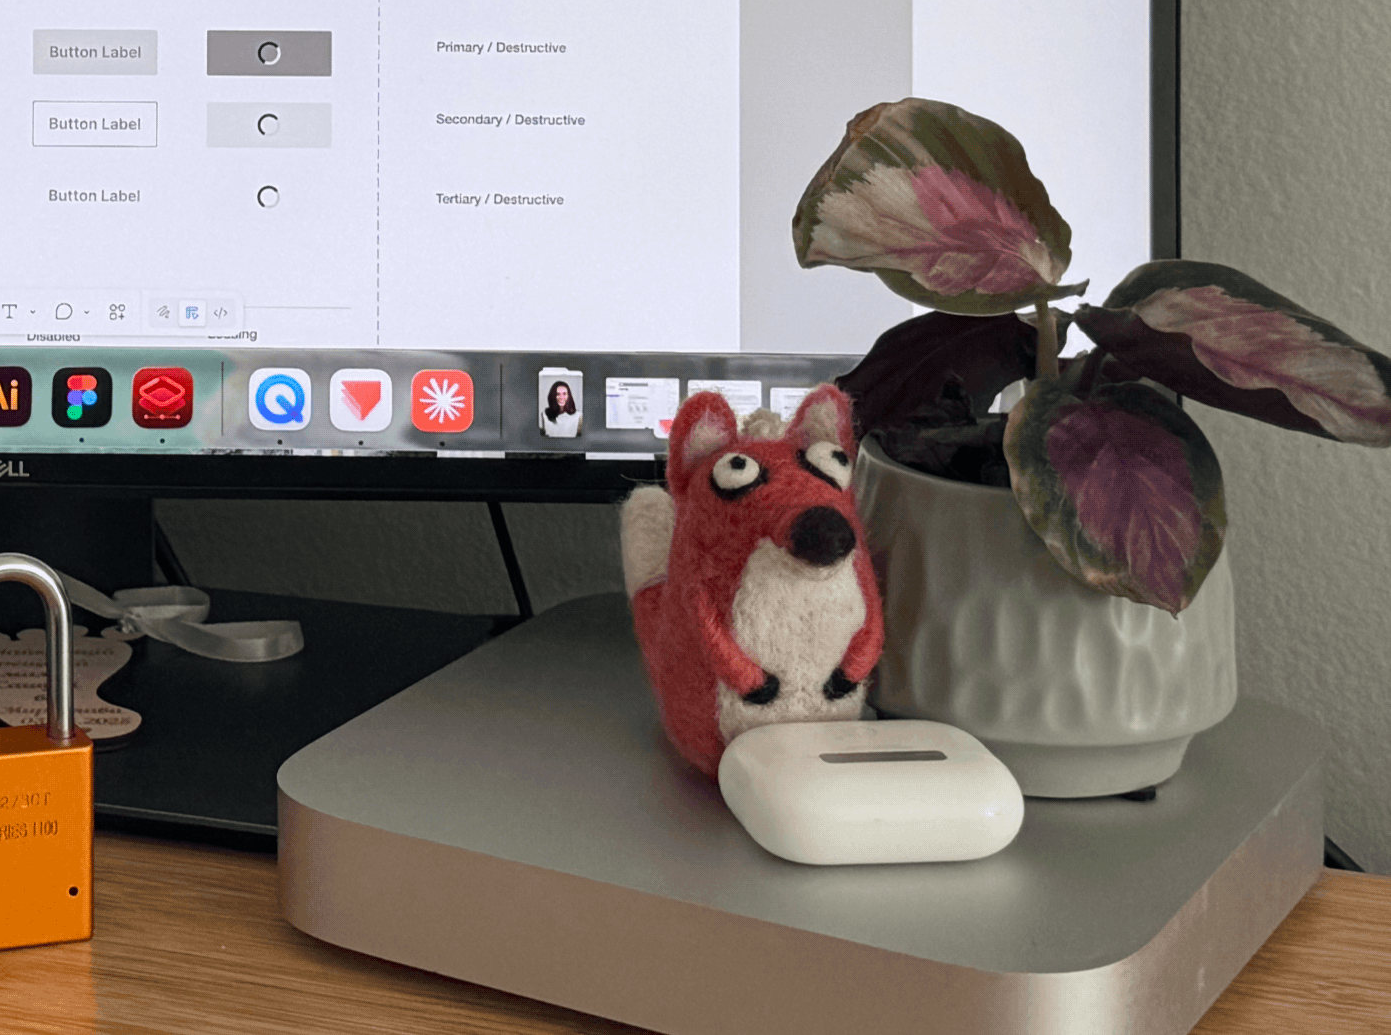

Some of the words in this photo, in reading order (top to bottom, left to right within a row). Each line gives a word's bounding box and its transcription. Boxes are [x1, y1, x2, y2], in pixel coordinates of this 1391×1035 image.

[437, 42, 484, 55] Primary
[497, 42, 566, 53] Destructive
[436, 193, 481, 206] Tertiary
[494, 194, 564, 205] Destructive
